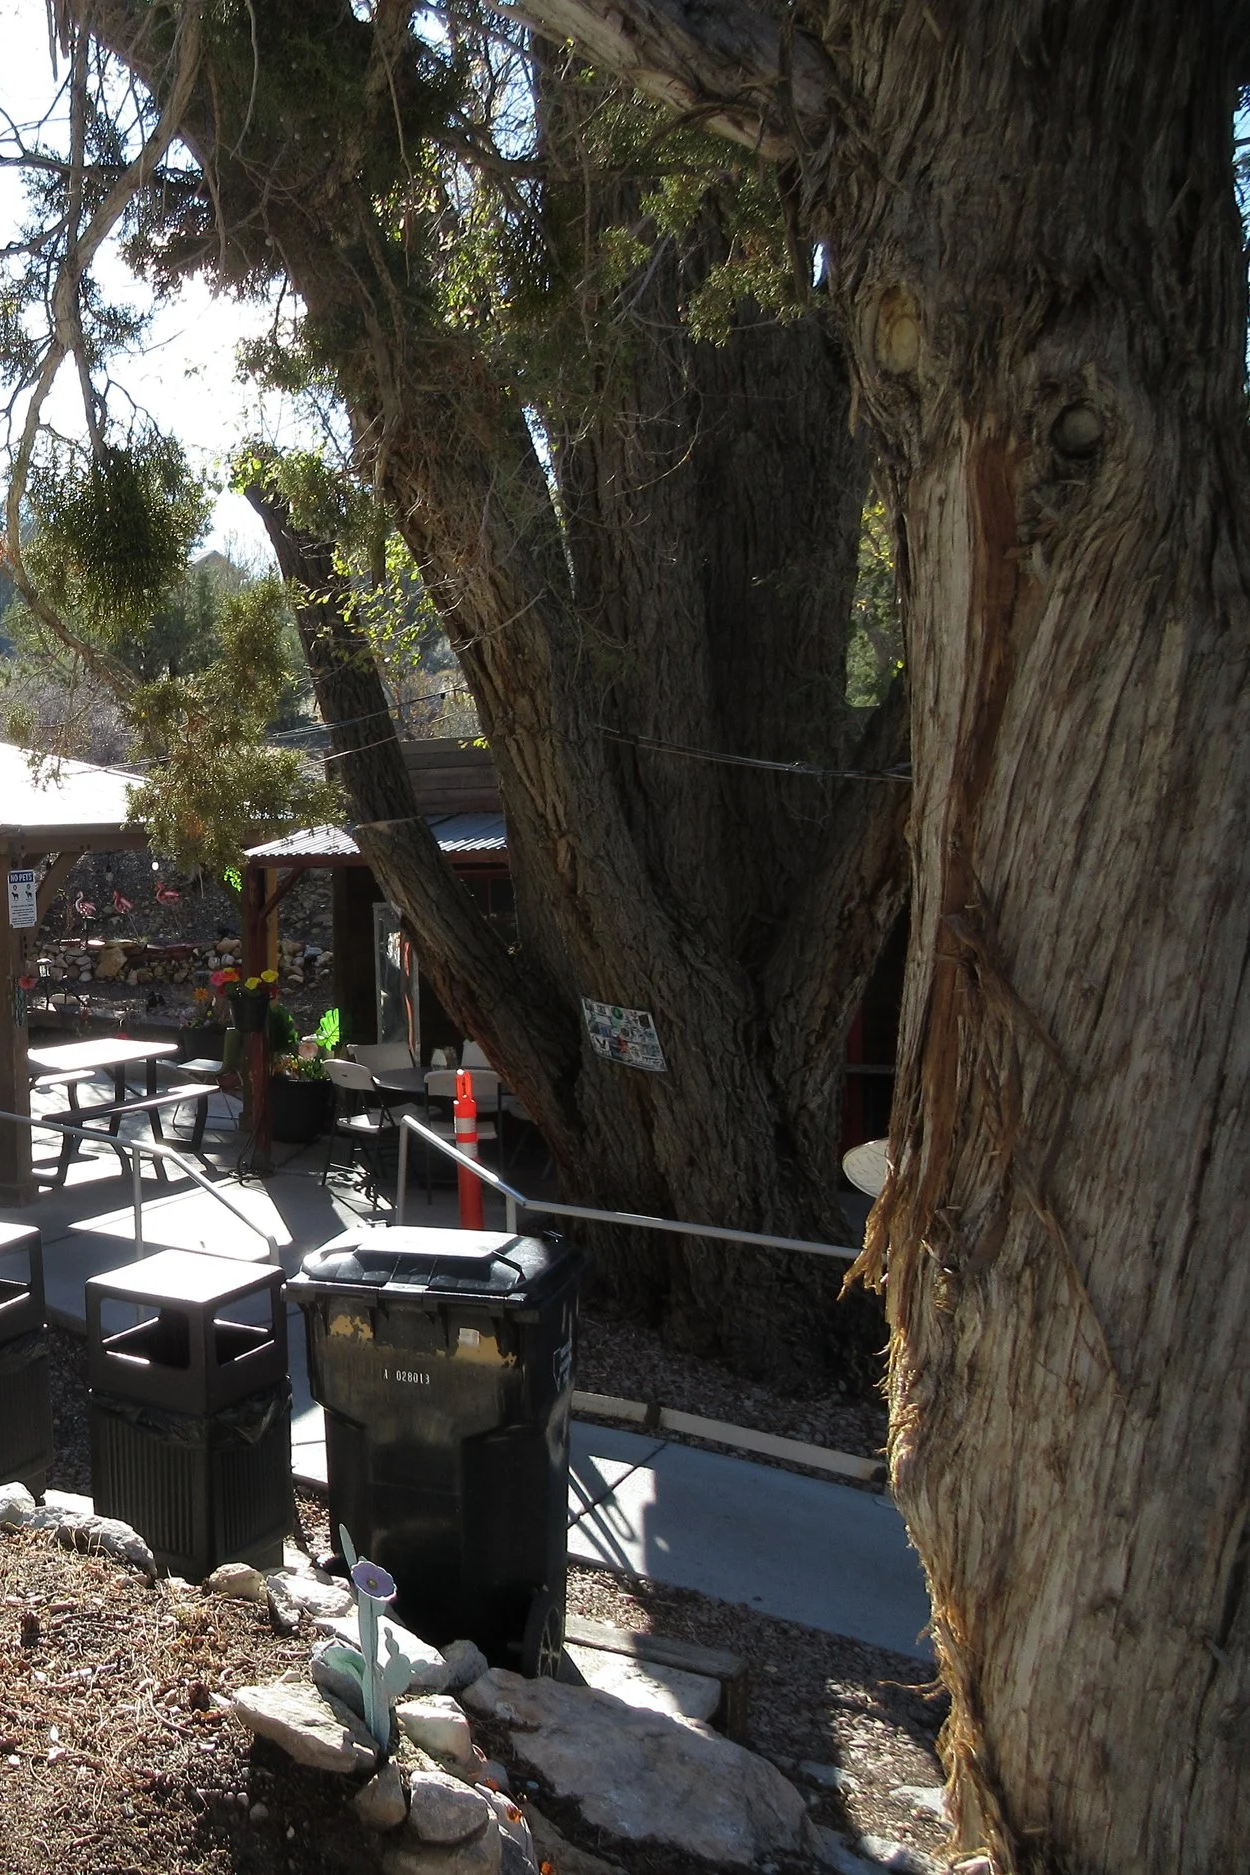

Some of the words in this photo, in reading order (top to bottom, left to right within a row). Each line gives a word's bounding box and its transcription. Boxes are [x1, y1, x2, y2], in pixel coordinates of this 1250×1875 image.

[10, 874, 18, 882] NO
[19, 873, 32, 882] PETS
[396, 1370, 430, 1384] 028013
